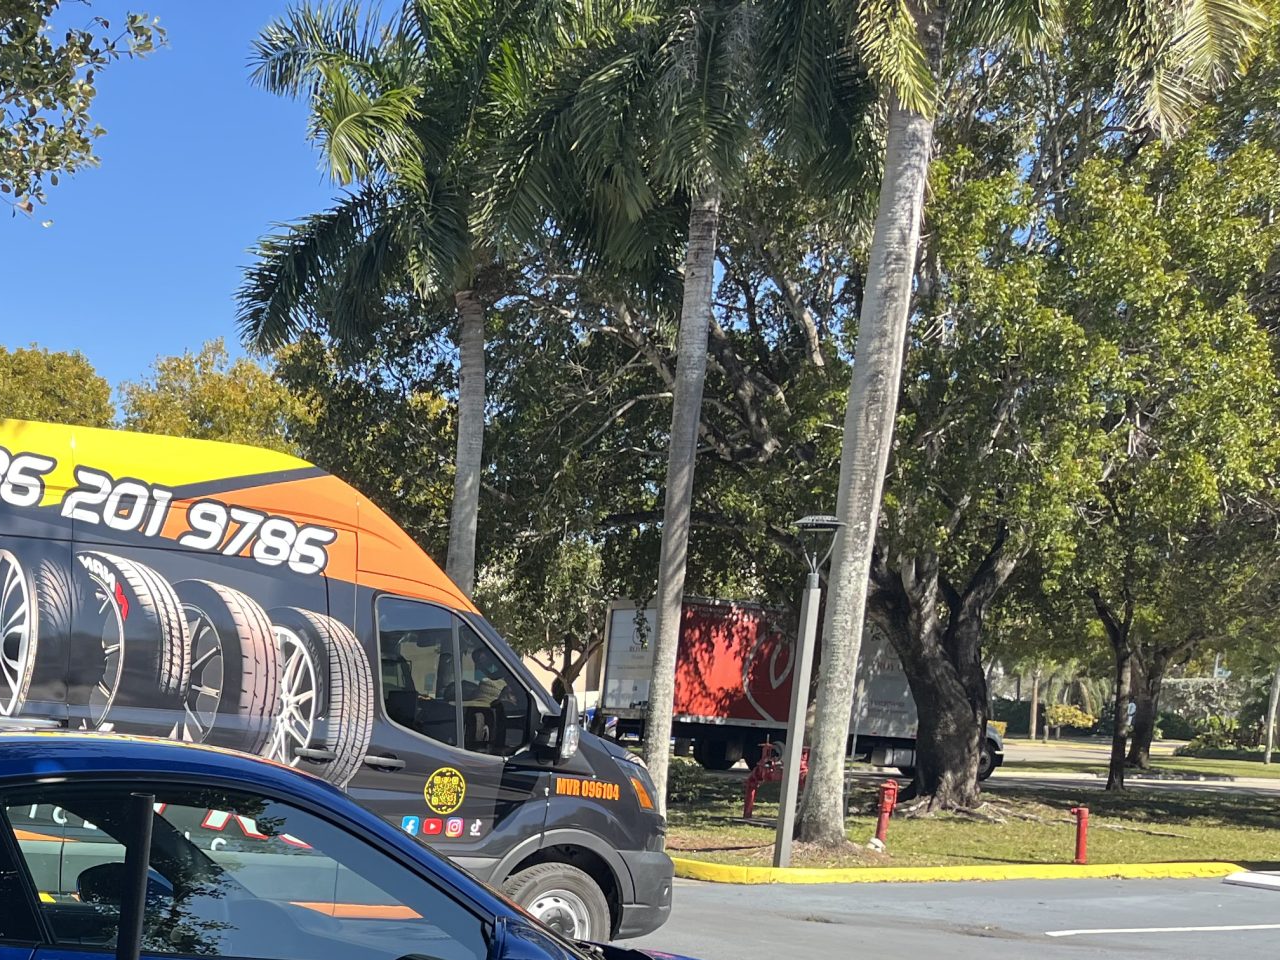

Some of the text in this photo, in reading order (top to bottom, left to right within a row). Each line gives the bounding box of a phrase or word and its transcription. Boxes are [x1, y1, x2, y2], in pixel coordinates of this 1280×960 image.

[60, 469, 173, 538] 201
[179, 503, 337, 576] 9786
[556, 777, 620, 801] MVR 096104
